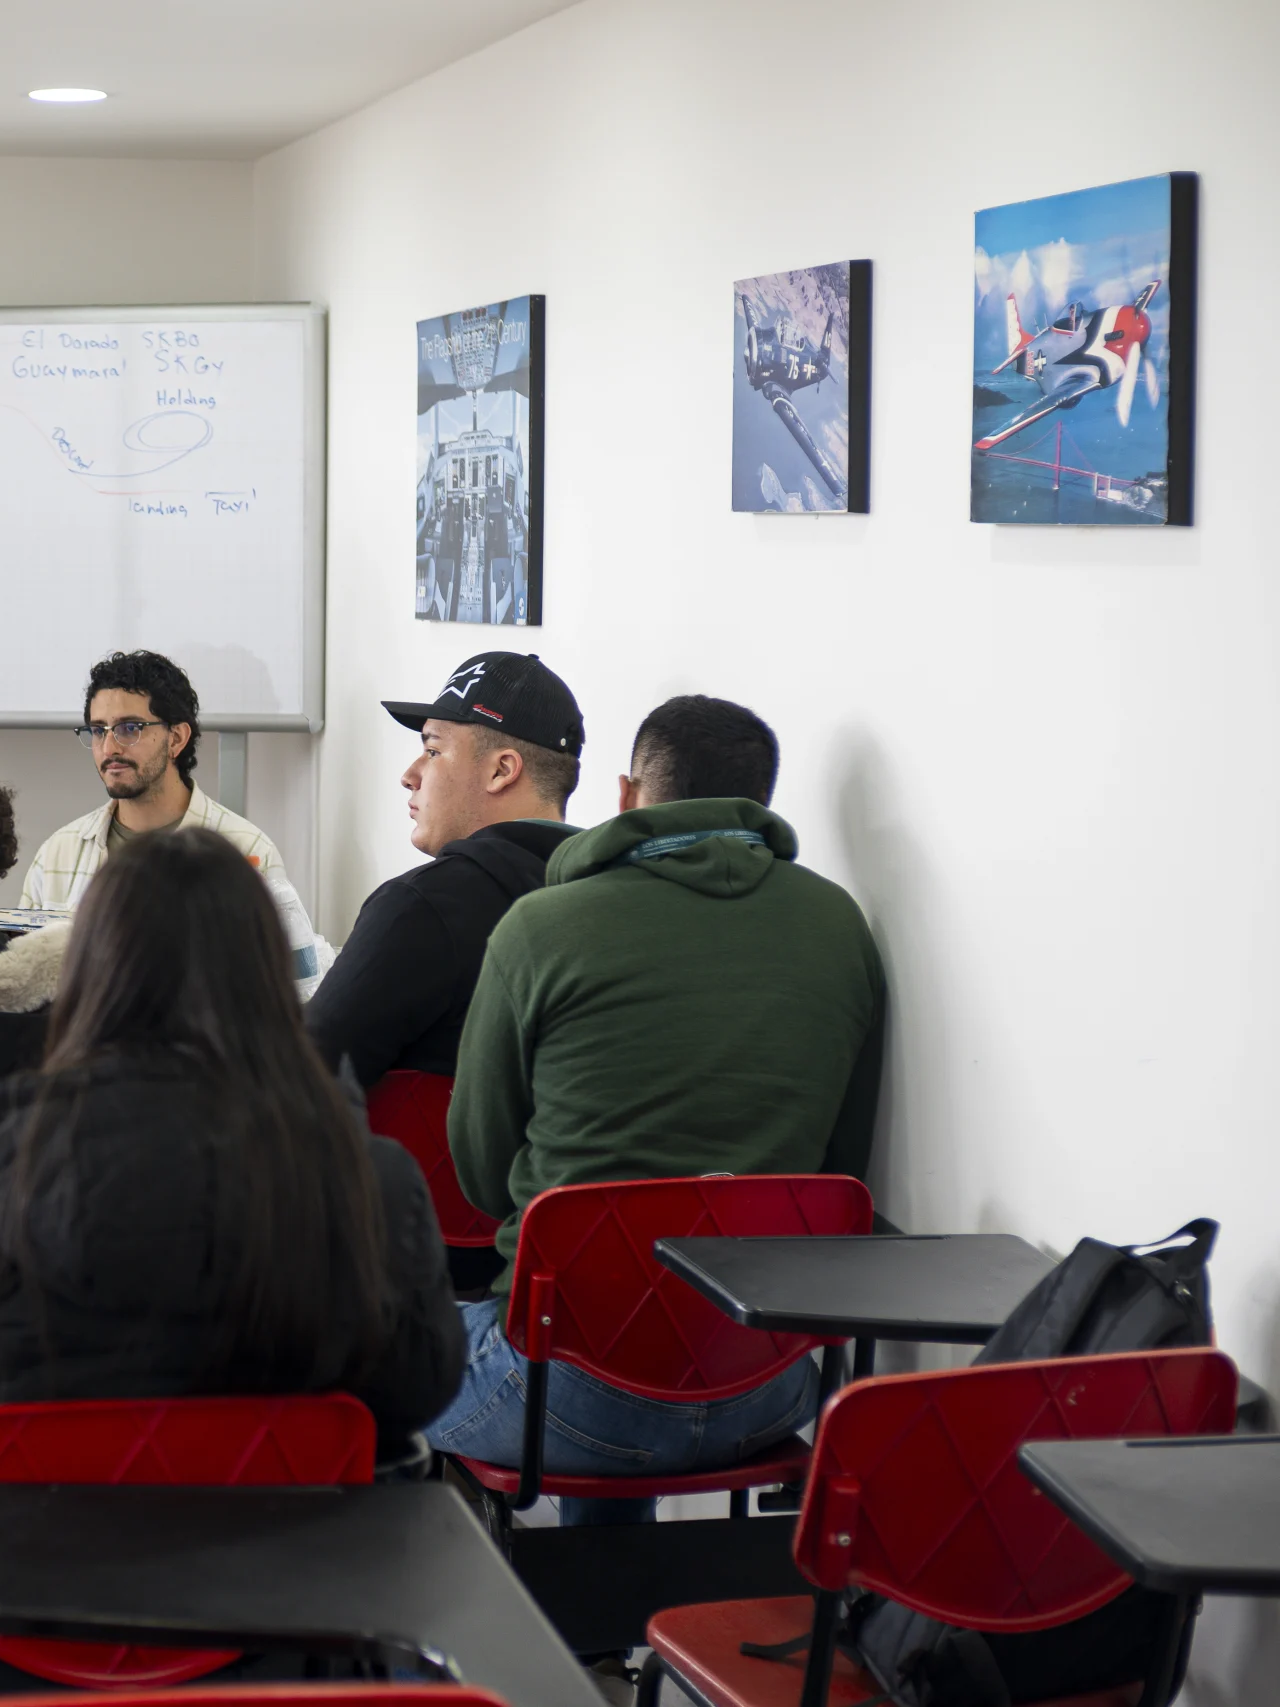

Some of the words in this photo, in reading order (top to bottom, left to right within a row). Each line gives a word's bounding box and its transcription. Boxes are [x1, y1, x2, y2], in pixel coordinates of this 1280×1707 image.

[22, 329, 44, 350] El
[58, 332, 120, 350] Dorado
[142, 330, 200, 349] SKBO
[421, 337, 433, 360] The
[434, 334, 462, 363] Flagship
[497, 318, 527, 347] Century
[788, 354, 800, 380] 75
[157, 388, 217, 410] Holding
[642, 839, 654, 849] LOS
